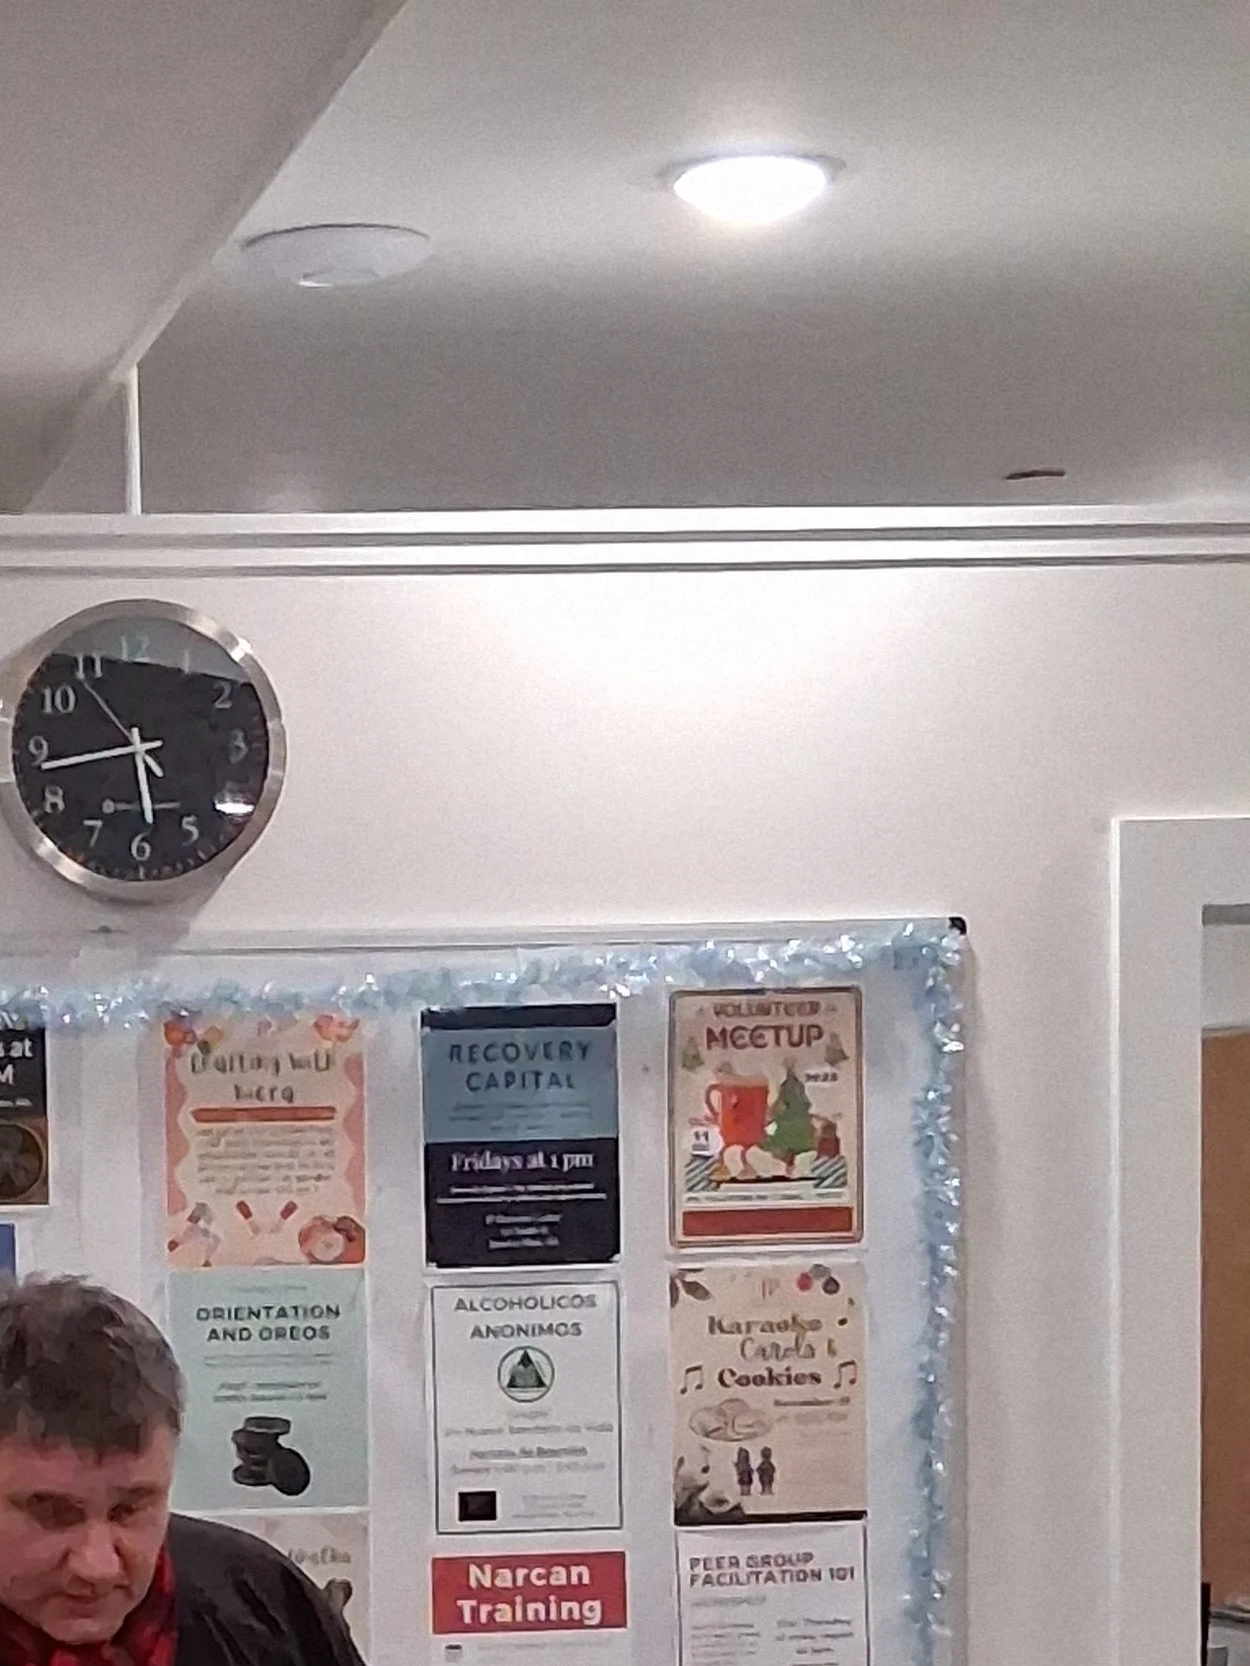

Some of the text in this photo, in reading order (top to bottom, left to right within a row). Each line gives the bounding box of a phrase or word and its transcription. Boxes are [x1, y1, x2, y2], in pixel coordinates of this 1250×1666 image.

[121, 635, 150, 662] 12
[183, 650, 190, 673] 1
[76, 653, 103, 680] 11
[42, 686, 76, 714] 10
[213, 683, 232, 709] 2
[28, 736, 49, 766] 9
[229, 731, 248, 764] 3
[43, 785, 65, 814] 8
[83, 819, 103, 848] 7
[181, 815, 199, 845] 5
[131, 834, 151, 861] 6
[10, 1038, 33, 1058] at
[705, 1024, 824, 1050] MEETUP
[449, 1040, 592, 1065] RECOVERY
[466, 1067, 576, 1092] CAPITAL
[451, 1150, 523, 1174] Fridays
[527, 1151, 545, 1169] at
[562, 1153, 594, 1173] pm
[197, 1304, 341, 1322] ORIENTATION
[454, 1293, 598, 1313] ALCOHOLICOS
[207, 1326, 252, 1342] AND
[470, 1321, 583, 1340] ANONIMOS
[718, 1365, 823, 1388] Cookies
[469, 1561, 591, 1588] Narcan
[689, 1551, 815, 1572] PEER GROUP
[689, 1565, 856, 1588] FACILITATION 101
[456, 1594, 604, 1626] Training
